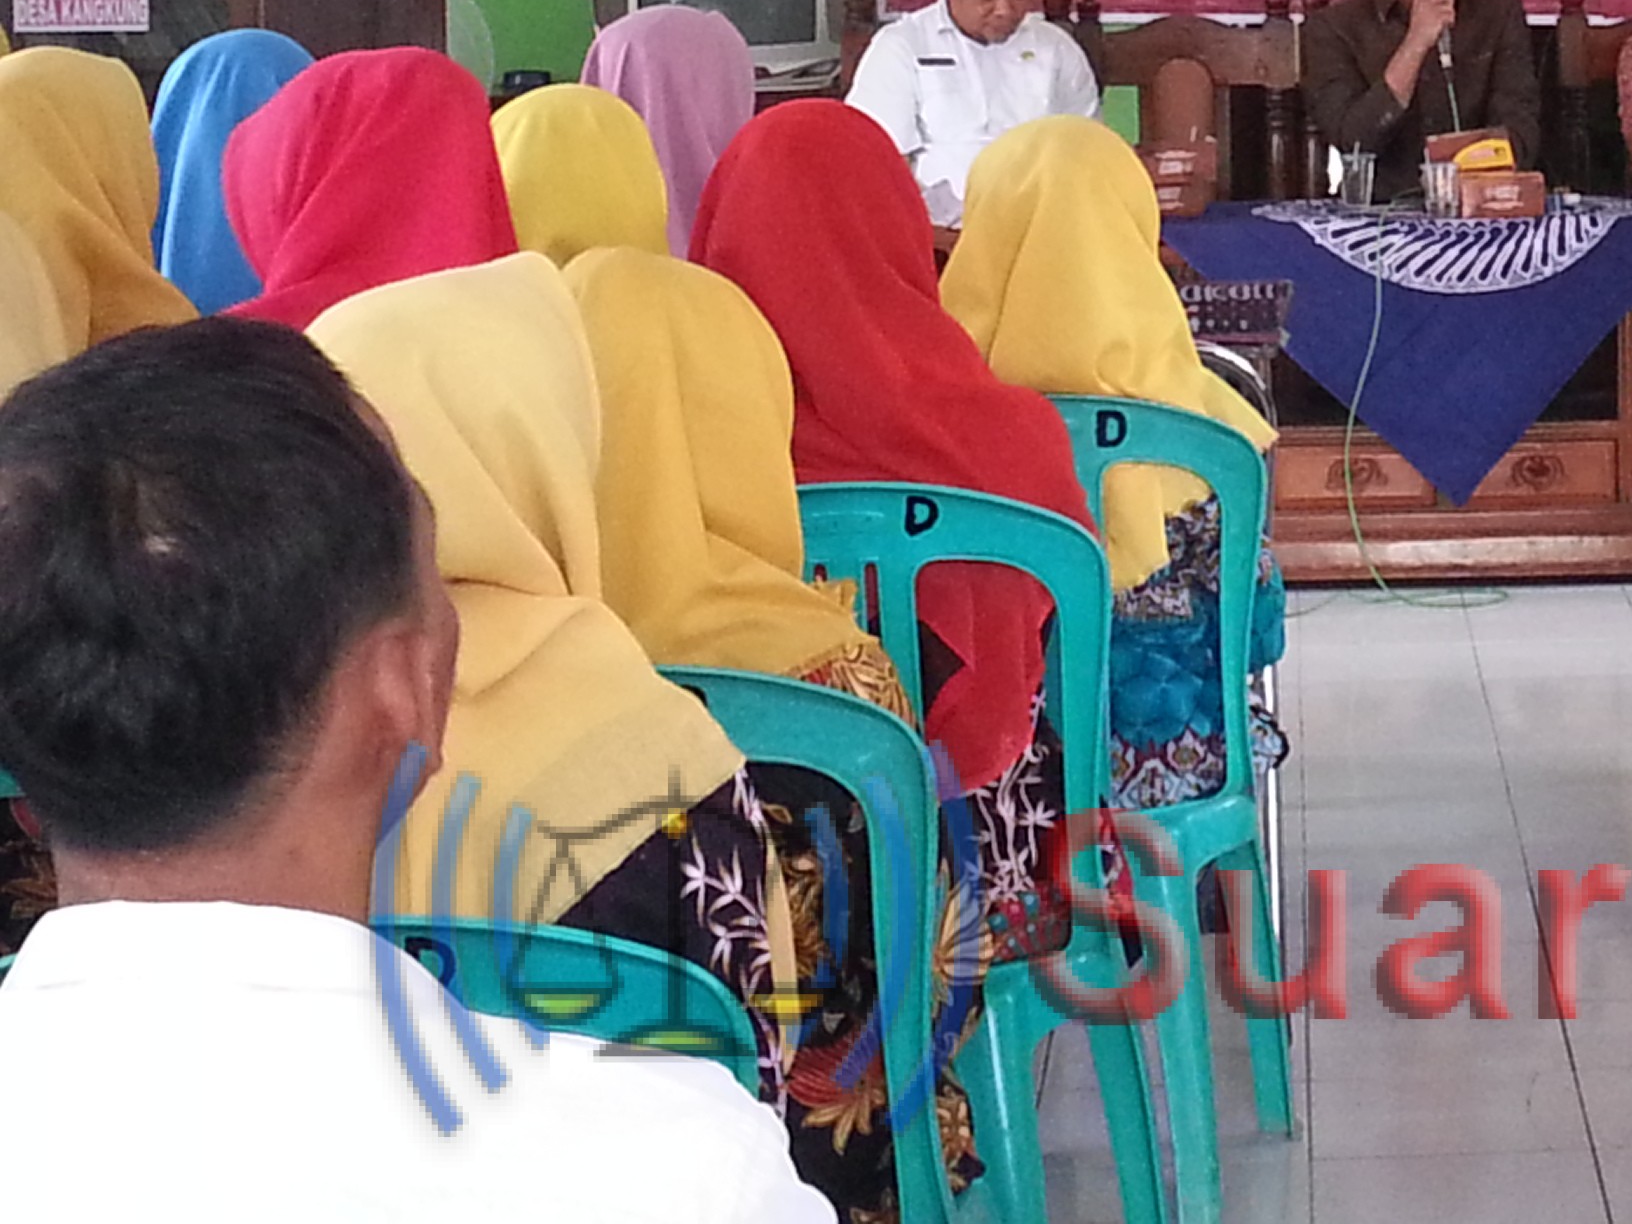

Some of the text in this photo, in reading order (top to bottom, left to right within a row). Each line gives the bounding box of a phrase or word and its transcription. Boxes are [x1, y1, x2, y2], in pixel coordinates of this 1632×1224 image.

[18, 0, 147, 23] DESA KANGKUNG
[1096, 410, 1127, 448] D
[905, 496, 938, 536] D
